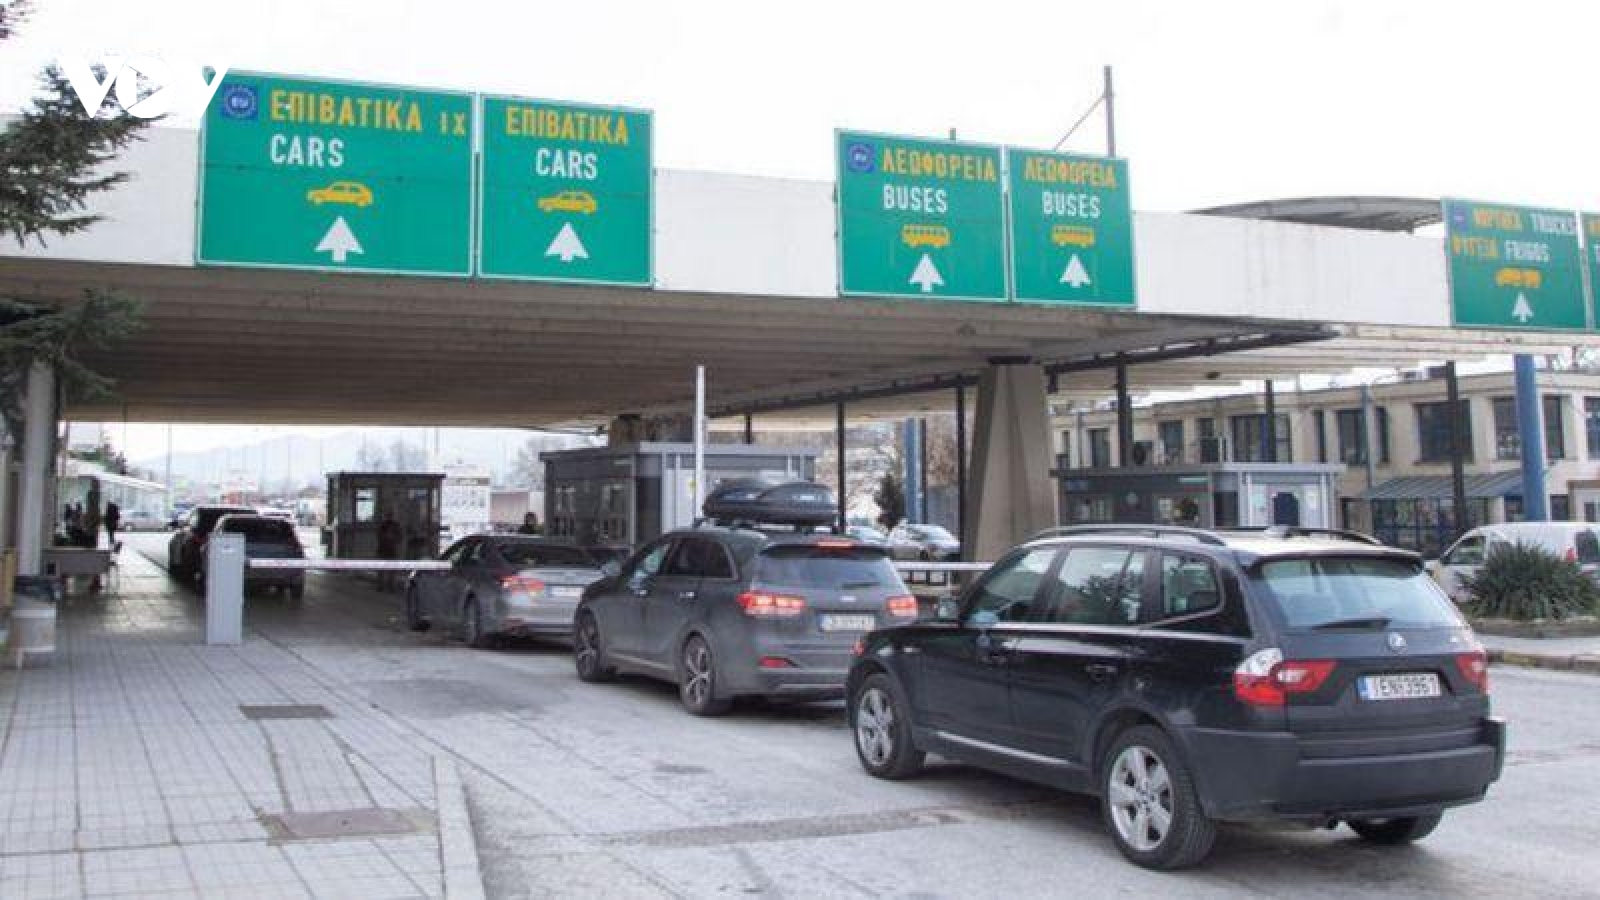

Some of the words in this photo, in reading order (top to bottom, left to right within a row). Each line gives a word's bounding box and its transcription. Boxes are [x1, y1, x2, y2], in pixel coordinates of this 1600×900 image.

[270, 88, 422, 133] ΕΠΙΒΑΤΙΚΑ
[505, 105, 629, 145] ΕΠΙΒΑΤΙΚΑ
[270, 132, 346, 168] CARS
[535, 147, 599, 180] CARS
[883, 183, 948, 214] BUSES
[1042, 190, 1101, 219] BUSES
